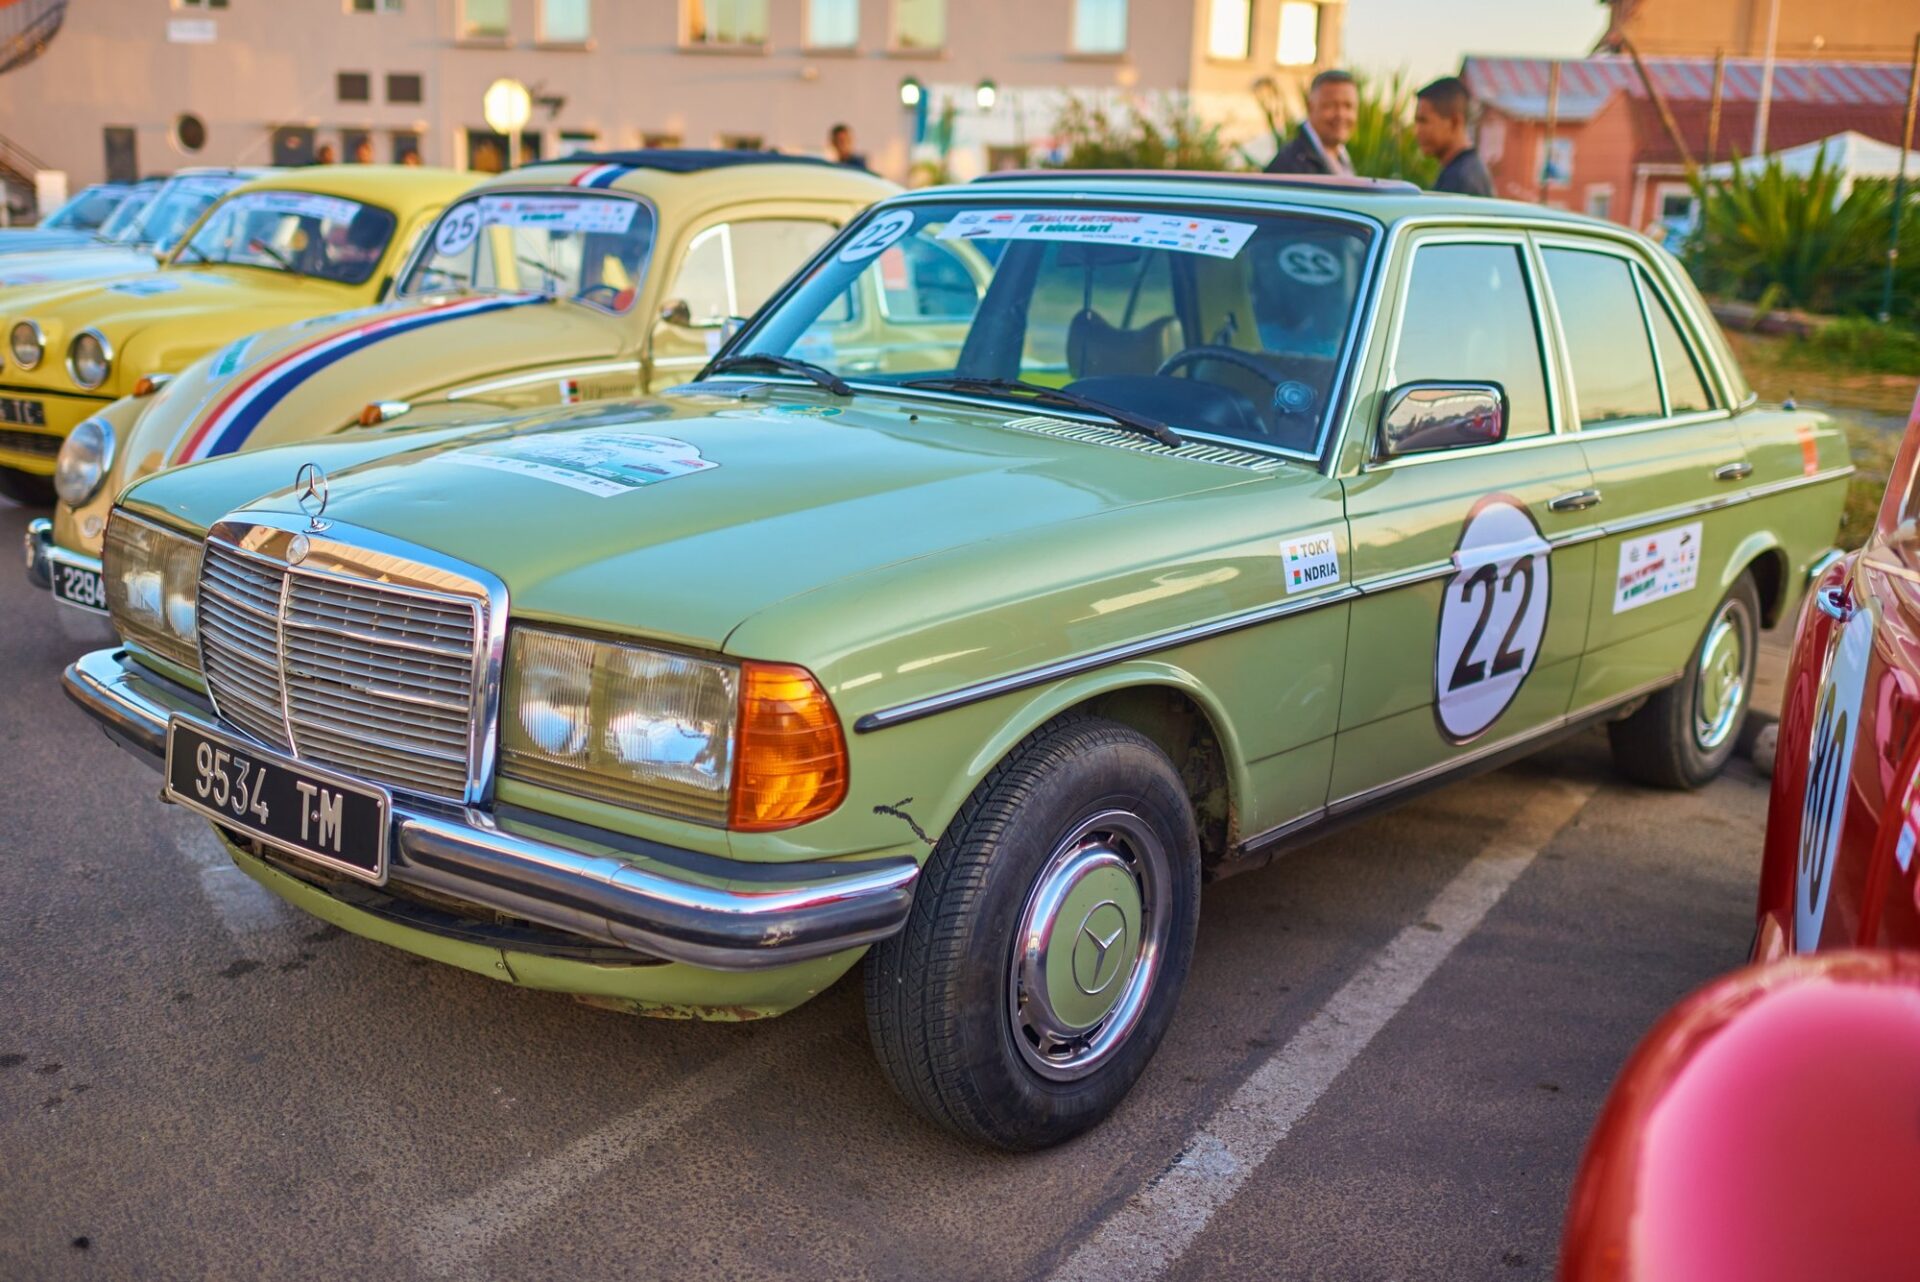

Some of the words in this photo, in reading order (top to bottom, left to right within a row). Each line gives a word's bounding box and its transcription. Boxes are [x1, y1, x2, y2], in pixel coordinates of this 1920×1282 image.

[443, 212, 476, 247] 25
[847, 221, 904, 251] 22
[1301, 539, 1329, 557] TOKY
[64, 567, 106, 608] 2294
[1304, 562, 1337, 582] NDRIA
[1448, 554, 1534, 693] 22
[196, 741, 269, 825] 9534
[296, 780, 343, 852] TM
